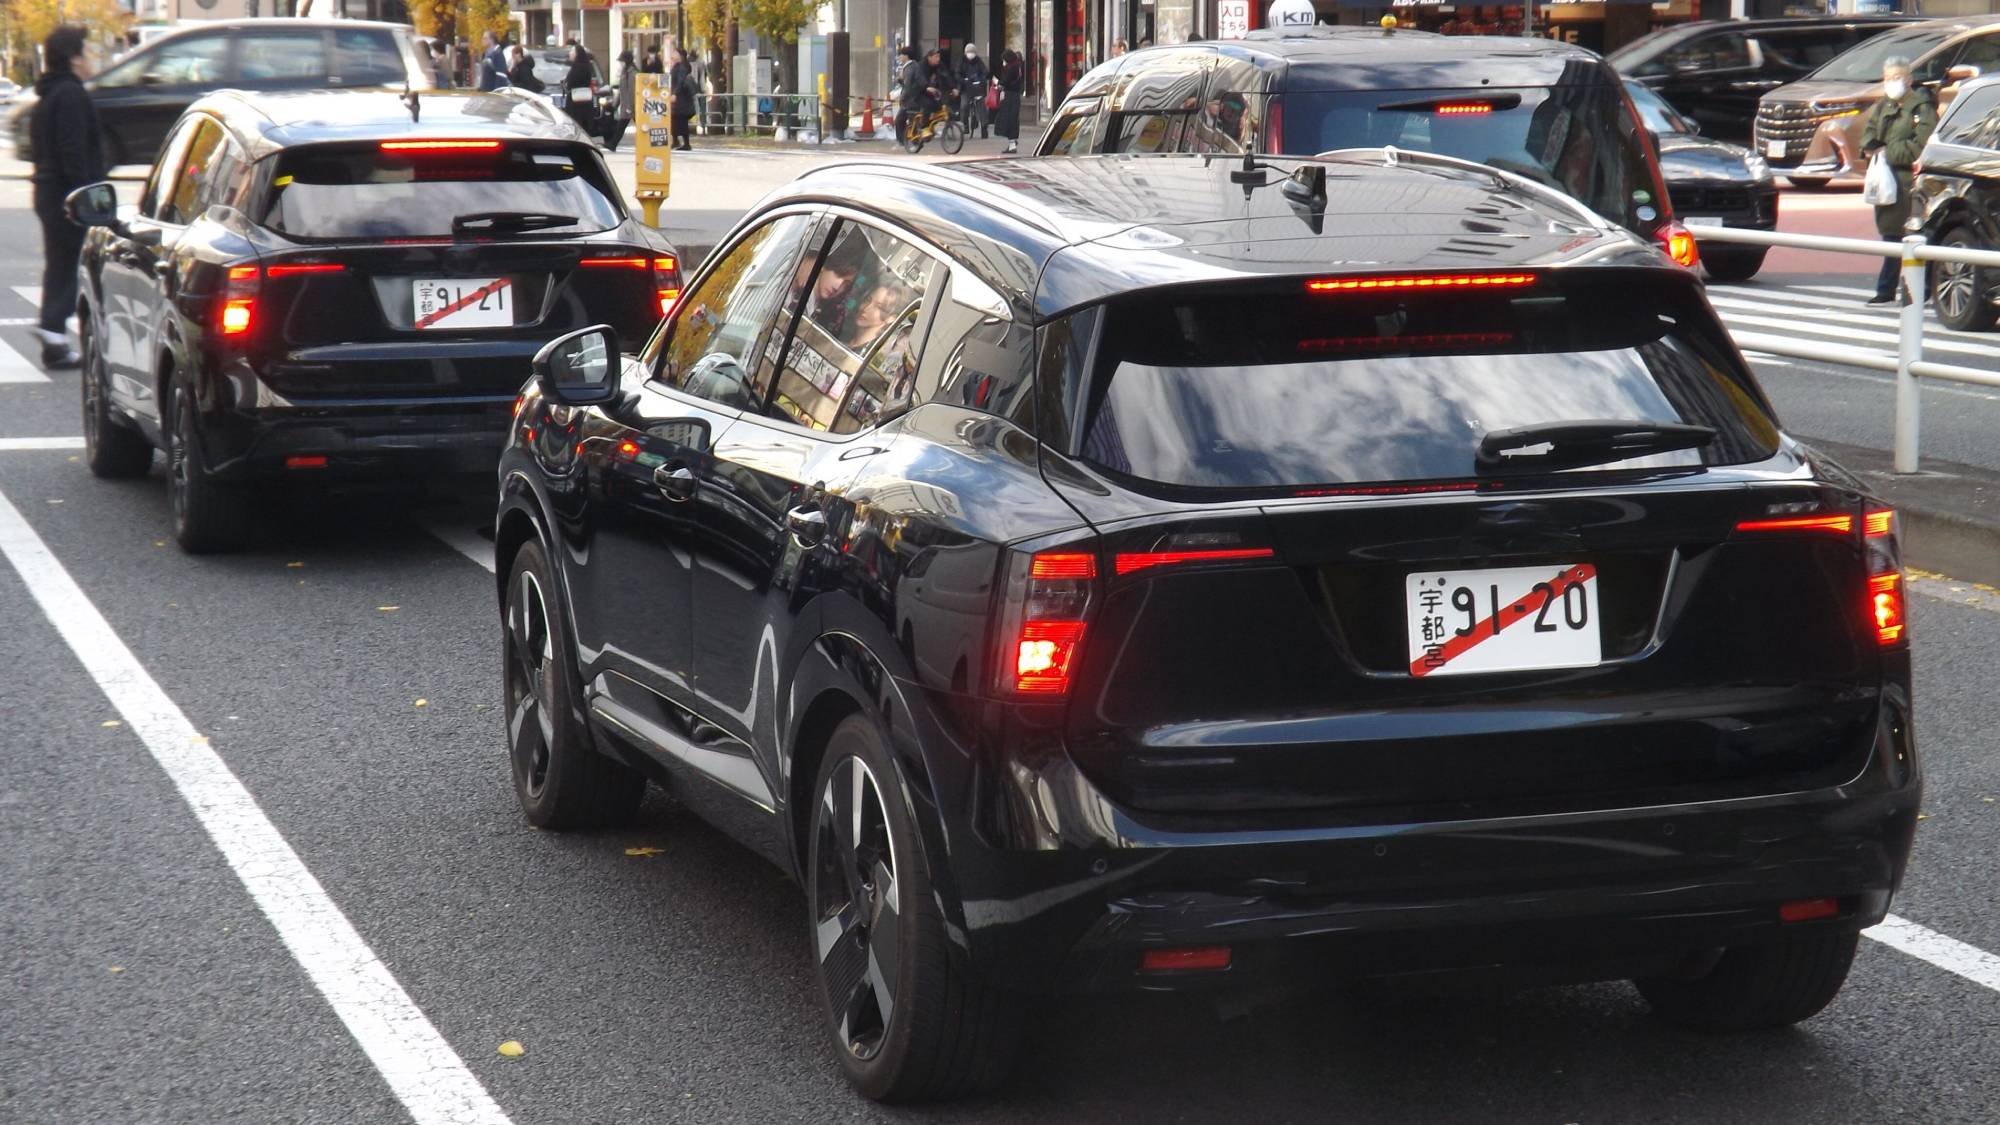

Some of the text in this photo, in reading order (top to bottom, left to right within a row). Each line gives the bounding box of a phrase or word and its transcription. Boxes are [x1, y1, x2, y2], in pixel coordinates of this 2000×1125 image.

[1222, 6, 1244, 17] 入口
[1218, 21, 1247, 31] こちら
[1419, 588, 1447, 667] 宇都宮
